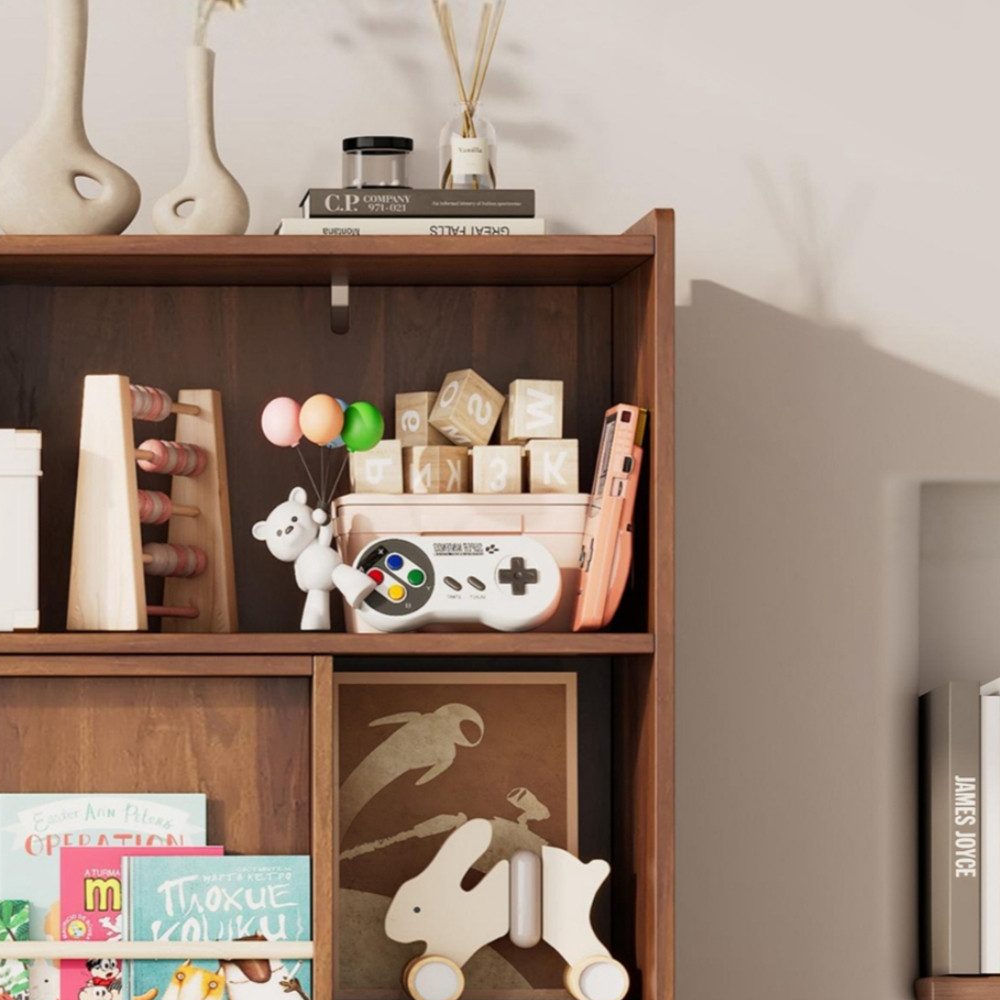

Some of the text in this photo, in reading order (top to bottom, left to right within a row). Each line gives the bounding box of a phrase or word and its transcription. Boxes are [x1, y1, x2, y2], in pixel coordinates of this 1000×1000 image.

[324, 193, 360, 212] C.P.
[363, 195, 411, 204] COMPANY
[954, 775, 976, 878] JAMES JOYCE
